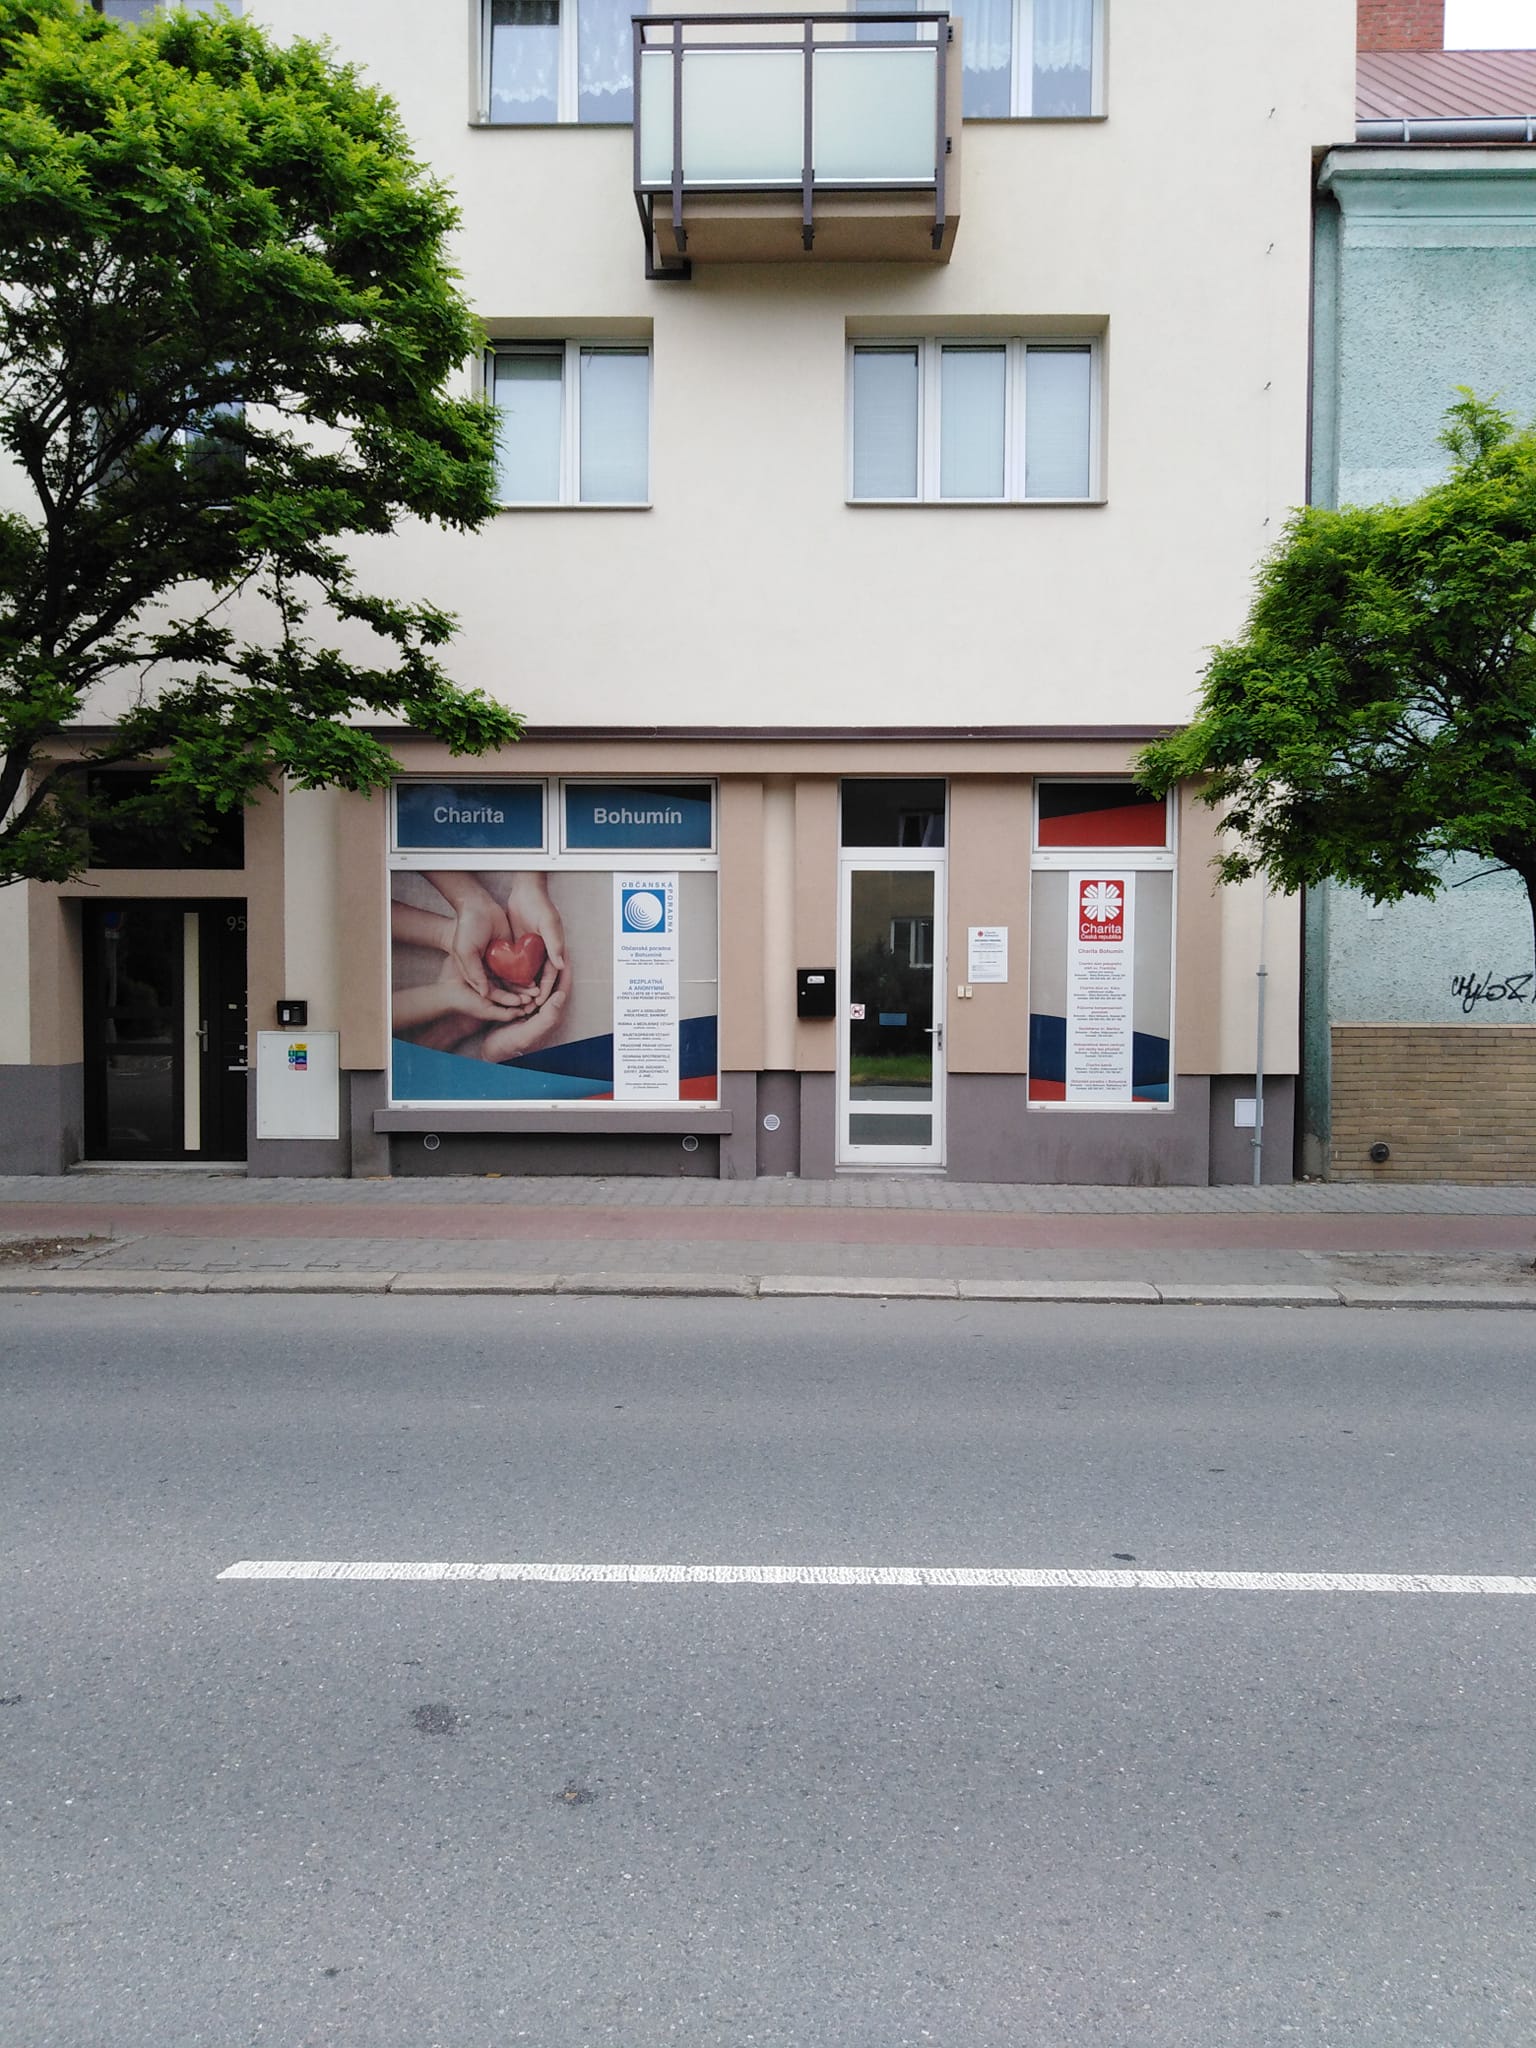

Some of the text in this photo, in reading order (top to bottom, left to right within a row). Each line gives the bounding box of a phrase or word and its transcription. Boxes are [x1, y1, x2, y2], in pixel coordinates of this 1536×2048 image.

[433, 806, 683, 825] Charita Bohumín
[226, 916, 247, 931] 95
[1081, 923, 1122, 934] Charita
